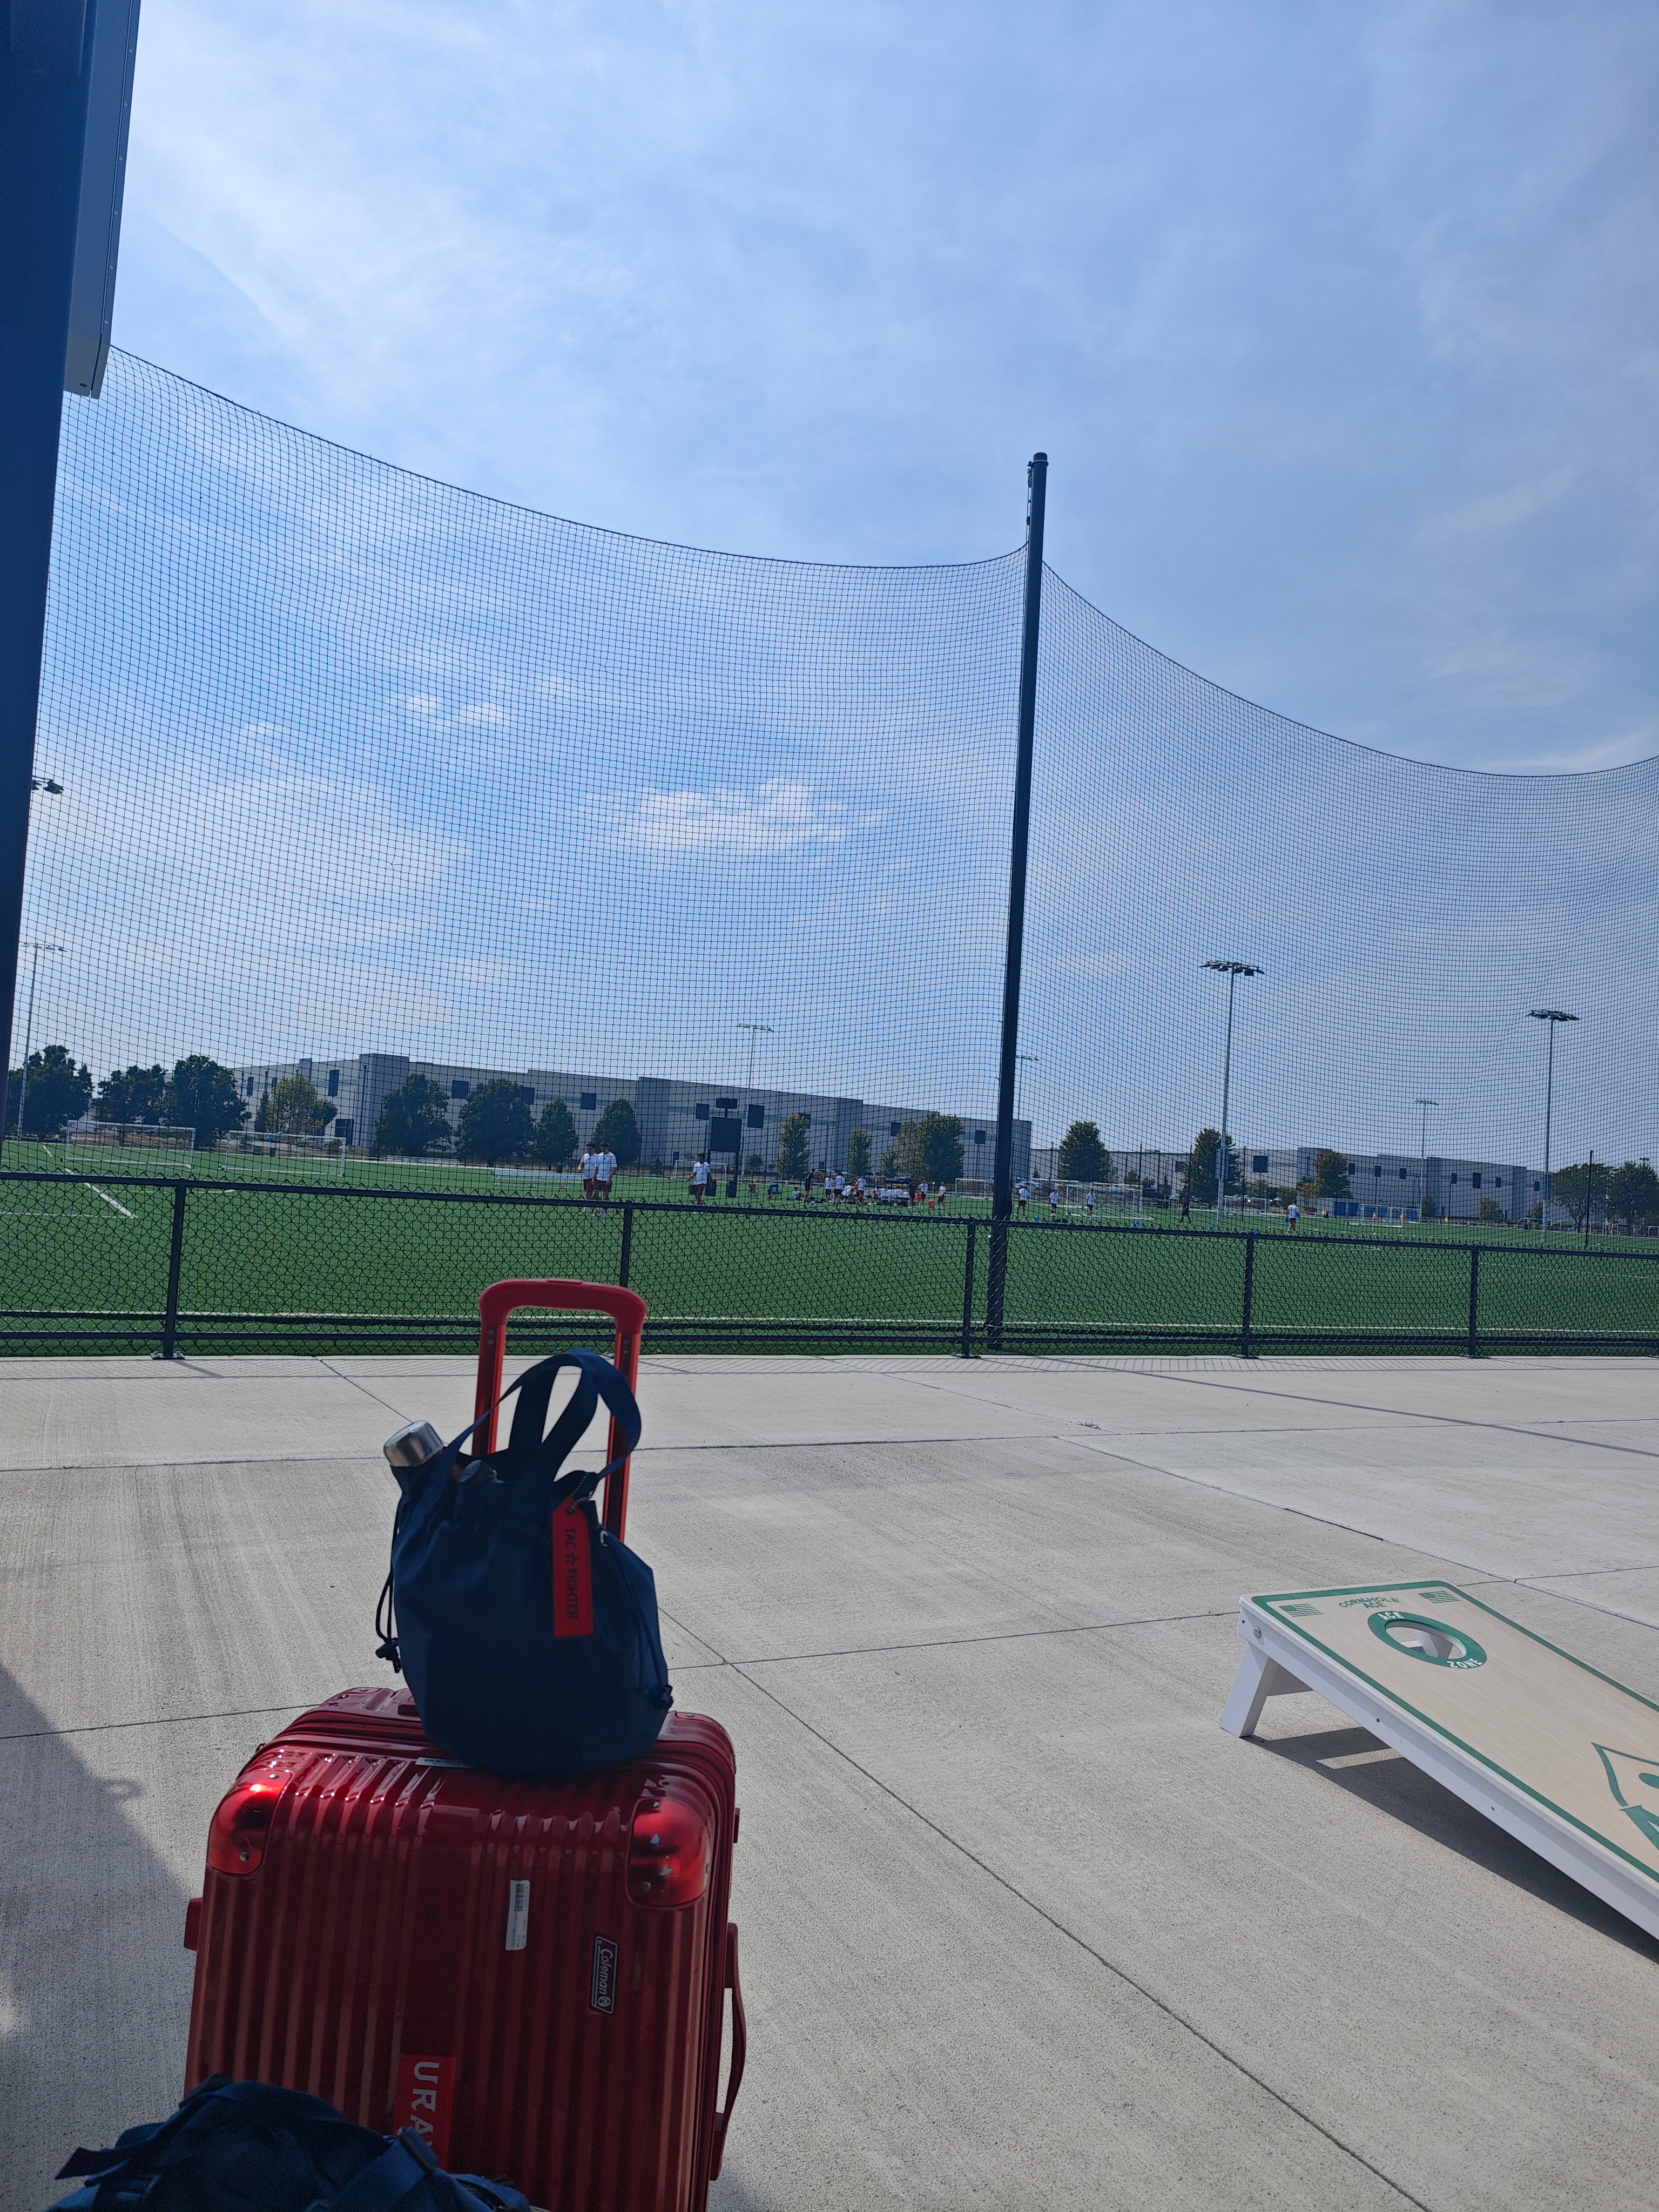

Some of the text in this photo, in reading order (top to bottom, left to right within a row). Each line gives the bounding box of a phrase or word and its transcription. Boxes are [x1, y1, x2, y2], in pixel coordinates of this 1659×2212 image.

[565, 1527, 579, 1620] TAC FIGHTER
[1377, 1611, 1405, 1621] ACE
[1446, 1657, 1483, 1668] ZONE
[598, 1948, 613, 1995] Coleman
[410, 2061, 440, 2147] URA
